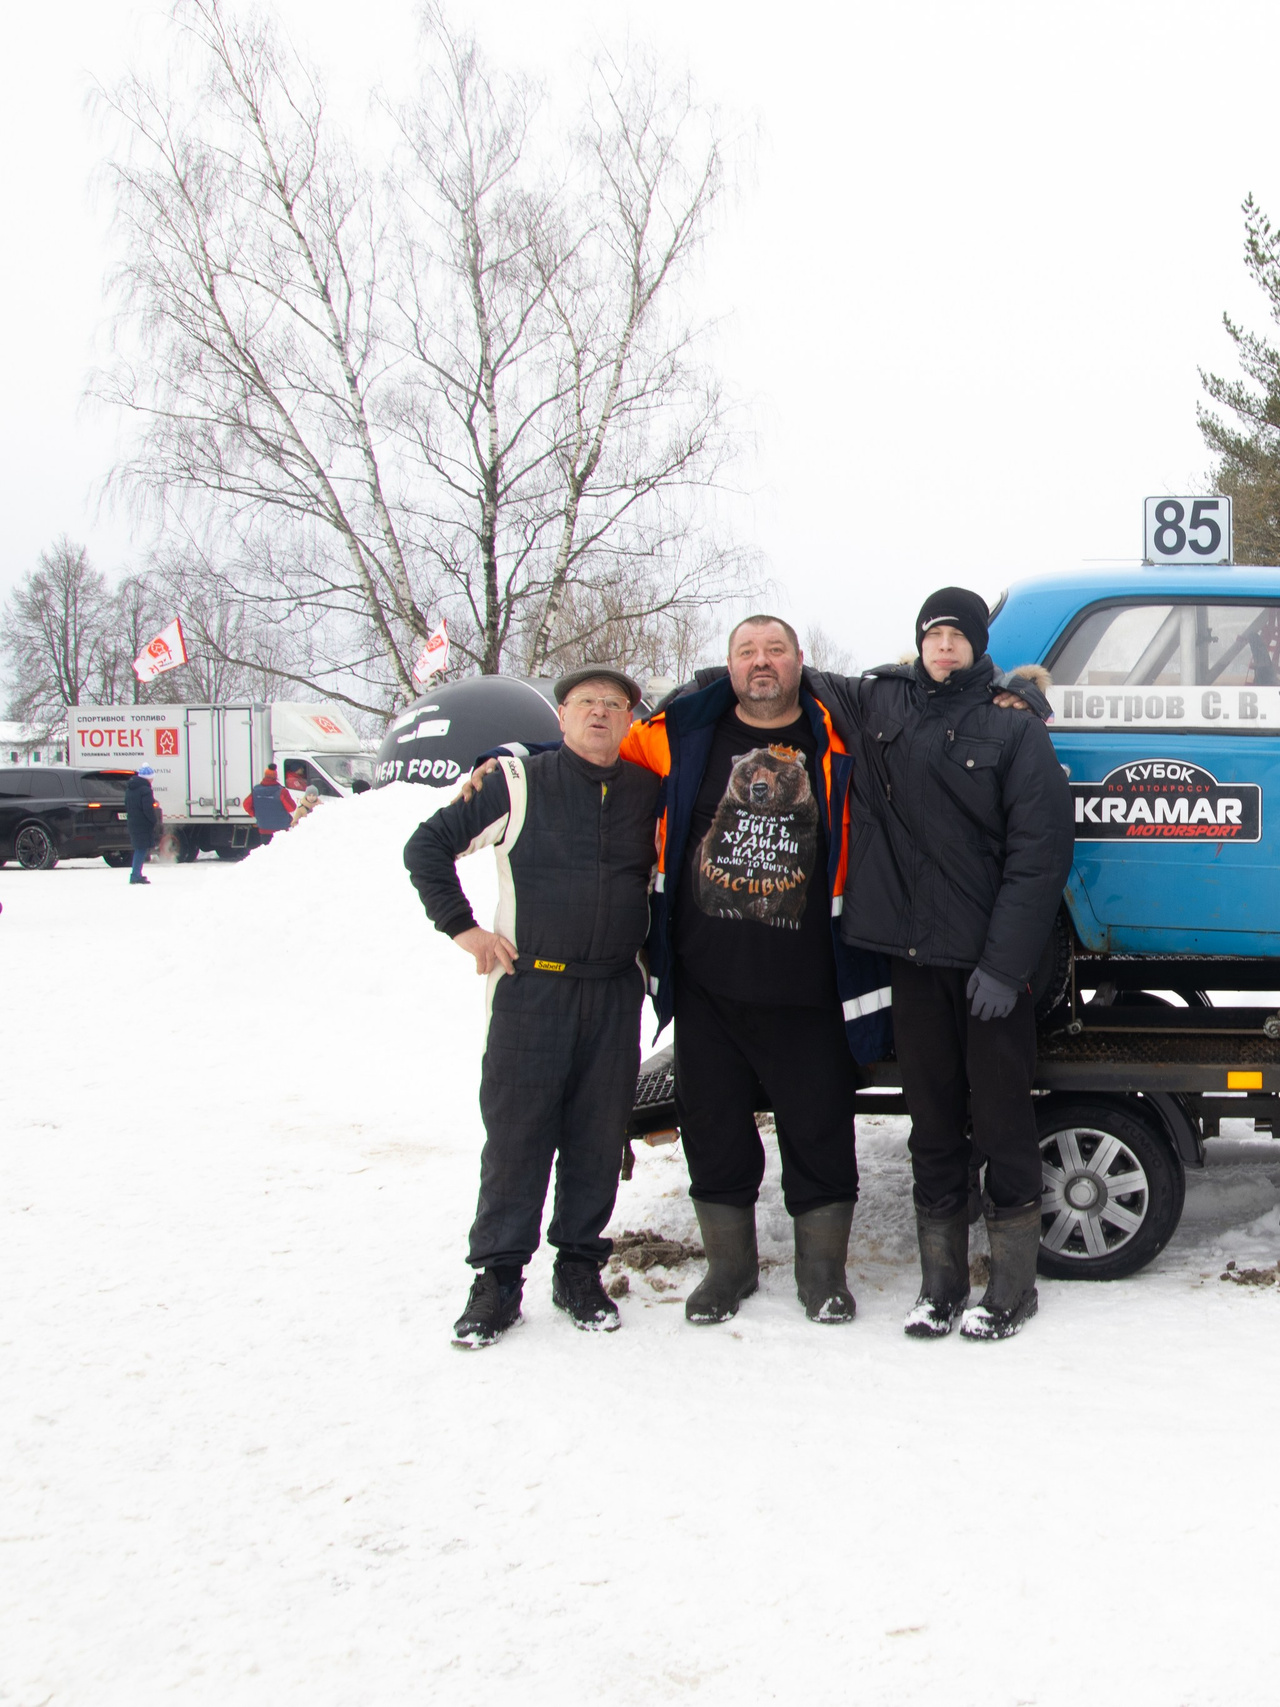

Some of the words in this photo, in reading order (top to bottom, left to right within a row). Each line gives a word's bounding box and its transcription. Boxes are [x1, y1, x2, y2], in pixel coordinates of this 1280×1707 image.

[1153, 500, 1221, 555] 85
[1064, 690, 1184, 722] Петров
[1201, 690, 1230, 720] С.
[1238, 690, 1267, 720] В.
[77, 715, 126, 723] СПОРТИВНОЕ
[77, 728, 144, 748] ТОТЕК
[407, 758, 461, 780] FOOD
[1125, 763, 1195, 784] КУБОК
[1131, 785, 1210, 793] АВТОКРОССУ
[1075, 797, 1243, 824] KRAMAR
[738, 819, 790, 839] БЫТЬ
[1126, 824, 1242, 837] MOTORSPORT
[721, 831, 798, 854] ХУДЫМИ
[732, 846, 776, 862] НАДО
[717, 856, 760, 868] КОМУ-ТО
[763, 862, 789, 874] БЫТЬ
[701, 858, 806, 896] КРАСИВЫМ
